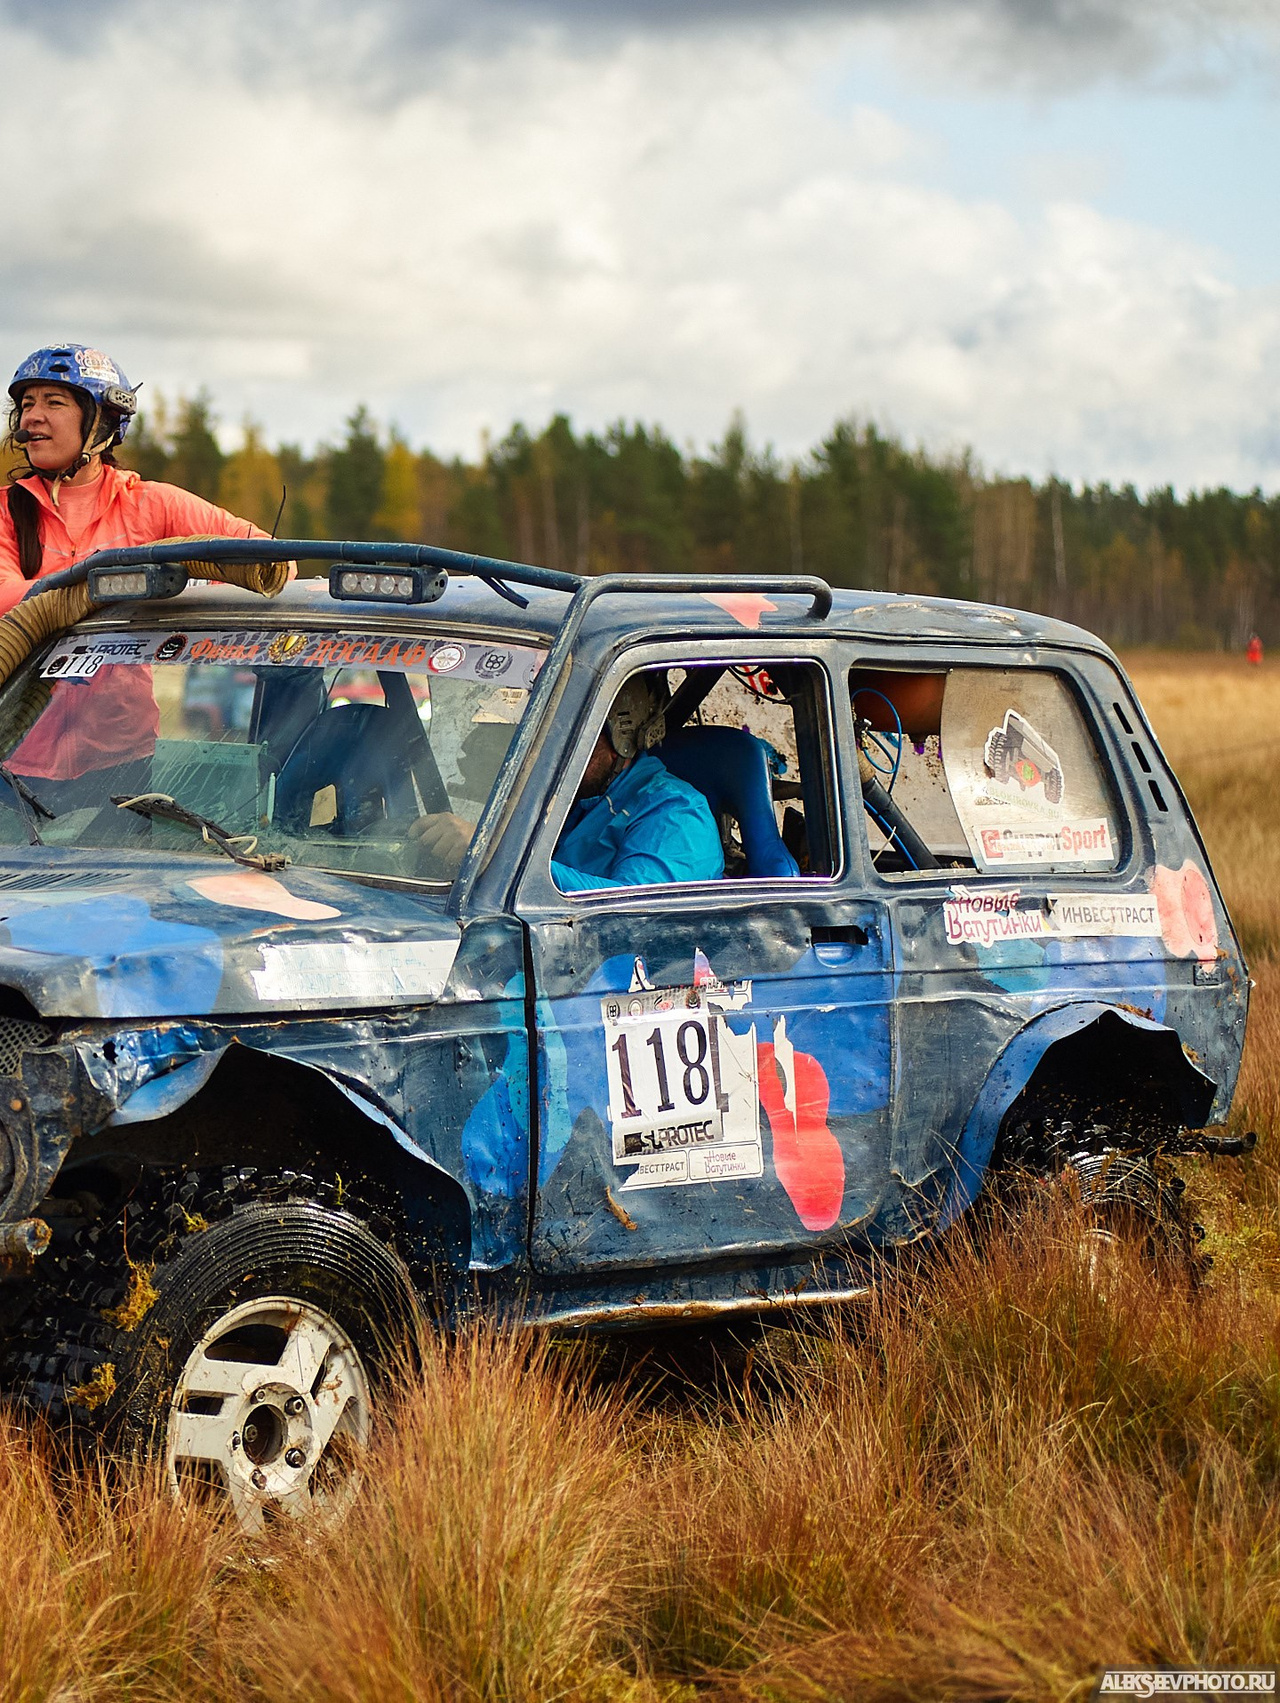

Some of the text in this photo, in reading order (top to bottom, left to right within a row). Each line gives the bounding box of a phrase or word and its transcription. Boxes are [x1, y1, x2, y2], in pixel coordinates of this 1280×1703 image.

[62, 655, 104, 675] 118
[304, 639, 426, 668] ДОСААФ
[948, 910, 1042, 942] Ватутинки
[1061, 906, 1155, 924] ИНВЕСТТРАСТ
[612, 1020, 710, 1119] 118
